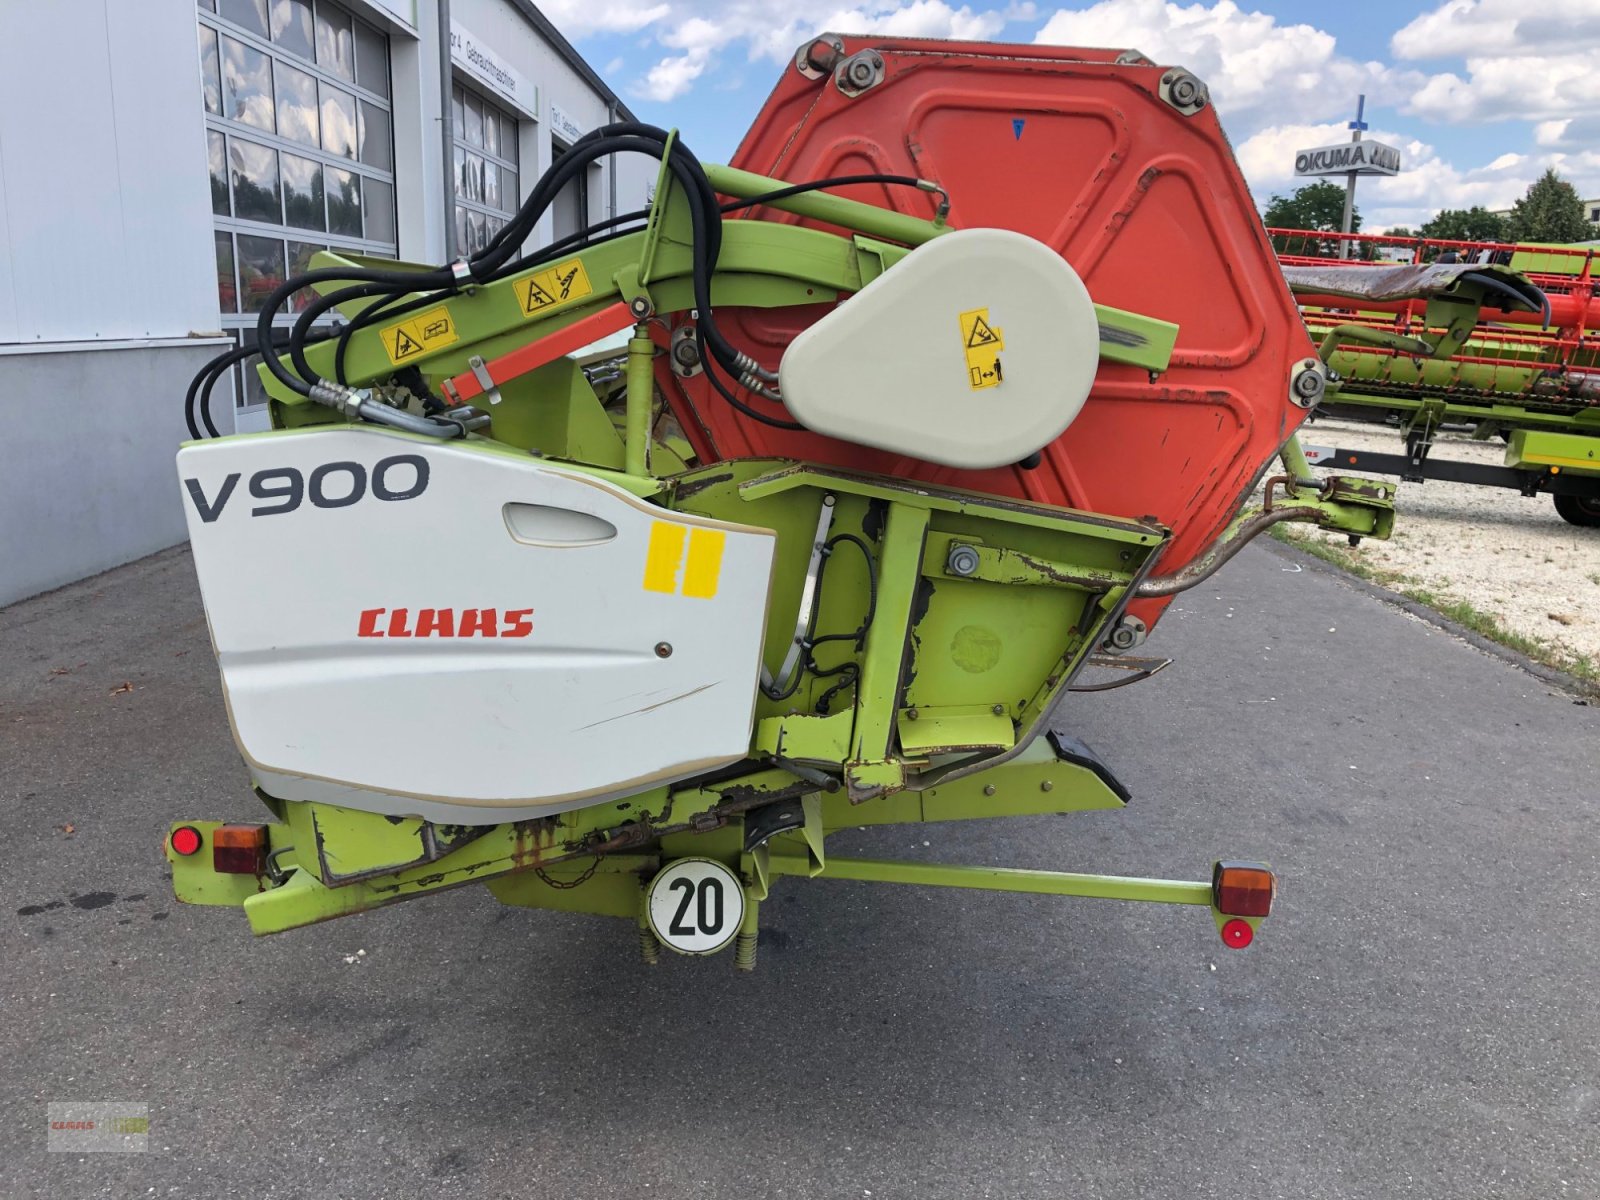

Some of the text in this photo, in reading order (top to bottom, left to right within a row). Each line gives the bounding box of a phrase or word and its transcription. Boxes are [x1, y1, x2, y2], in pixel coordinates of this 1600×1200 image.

[466, 40, 517, 92] Gebrauchtmaschinen
[1295, 146, 1367, 172] OKUMA
[184, 454, 430, 523] V900
[357, 607, 534, 638] CLAAS
[669, 876, 724, 936] 20
